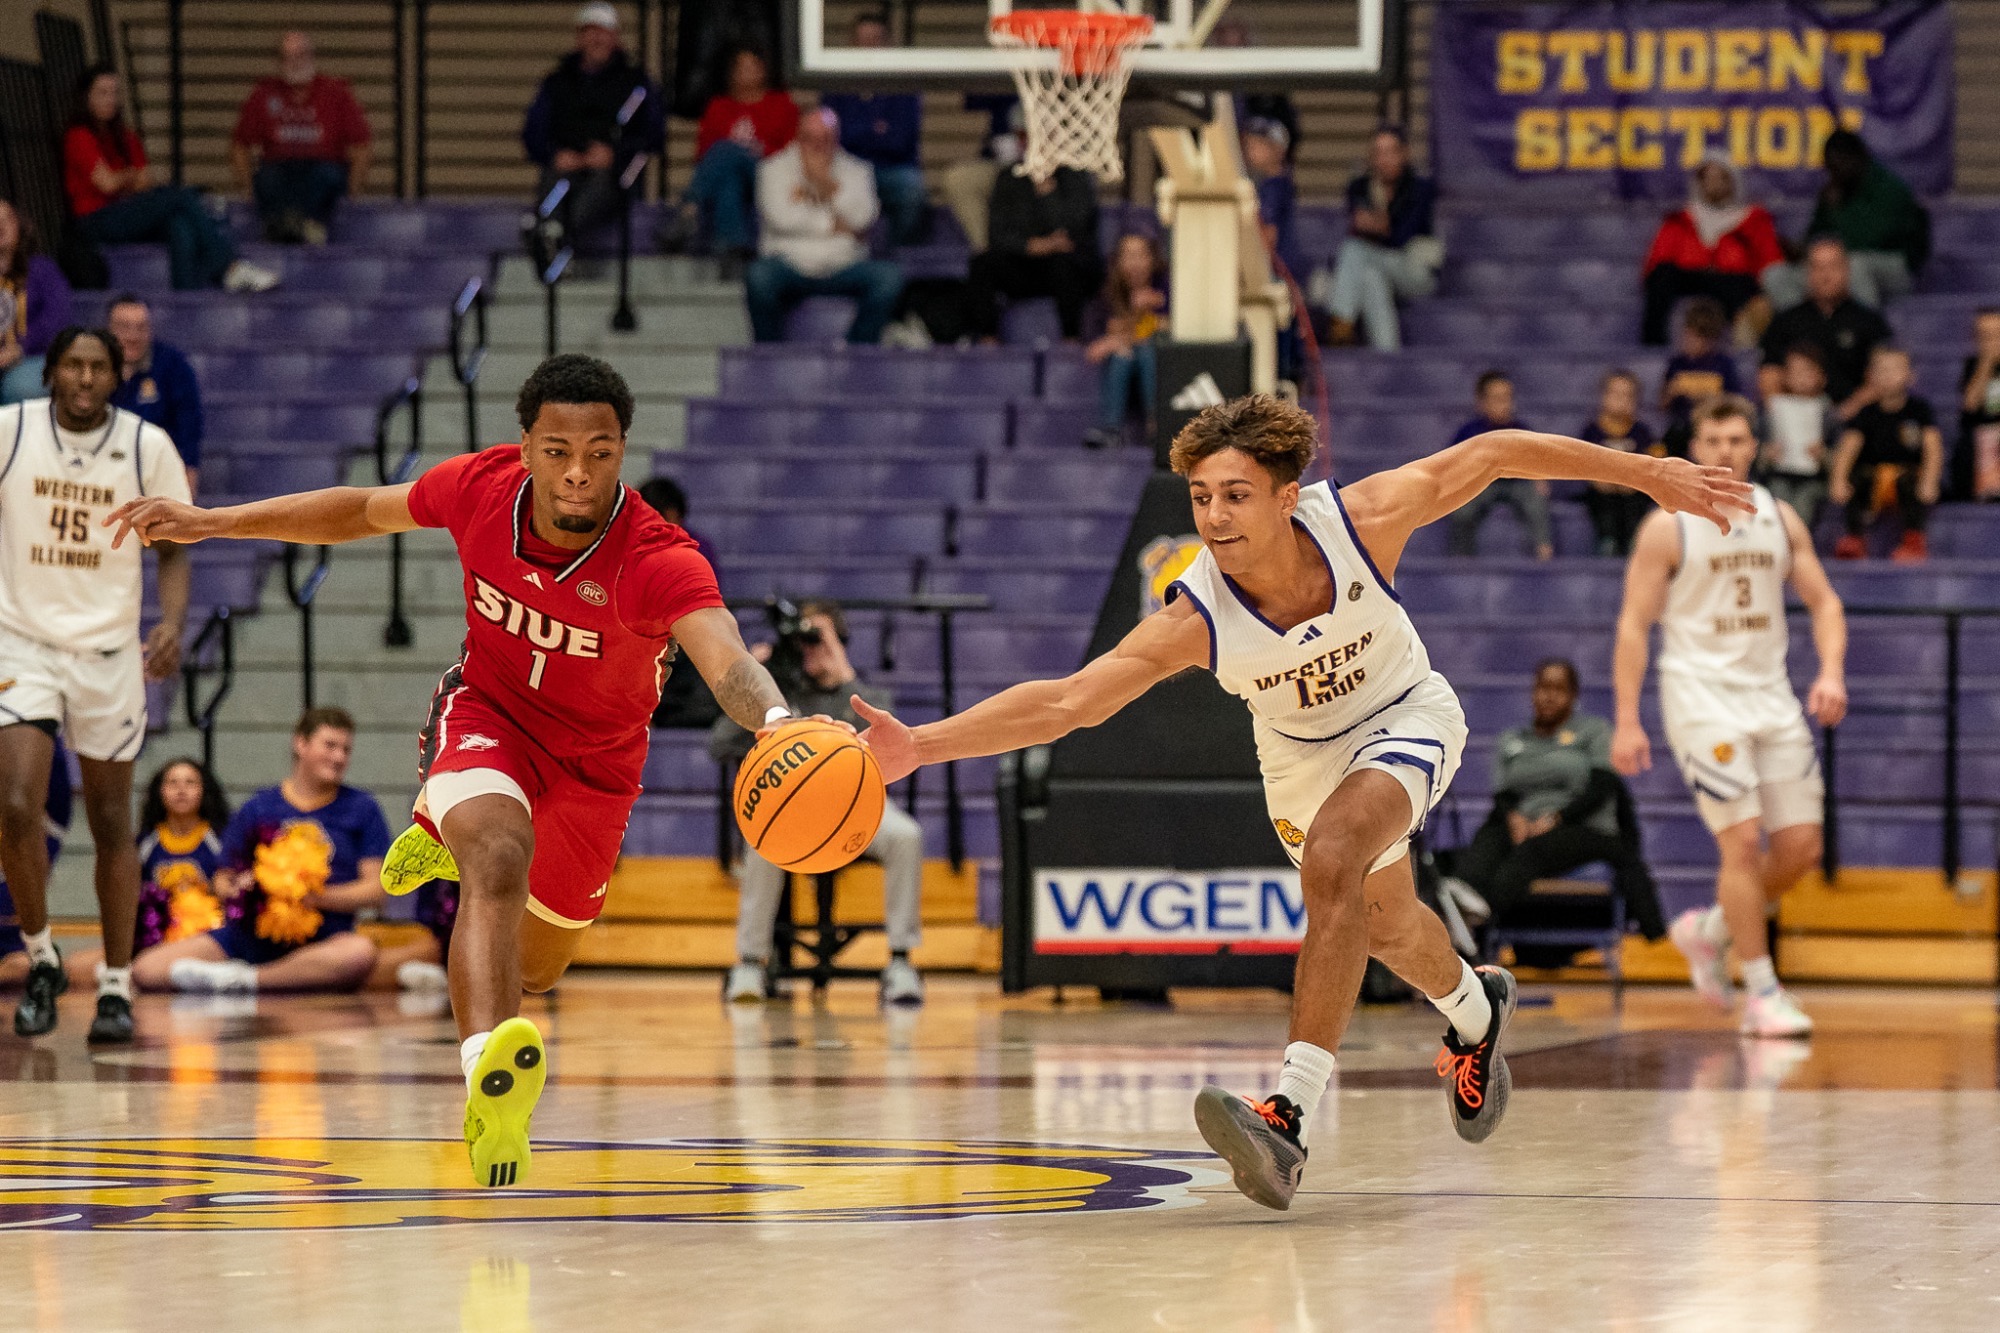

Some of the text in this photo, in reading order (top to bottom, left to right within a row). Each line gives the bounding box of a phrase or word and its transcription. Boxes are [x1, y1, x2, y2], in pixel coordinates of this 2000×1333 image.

[1497, 28, 1885, 94] STUDENT
[34, 477, 114, 507] WESTERN
[50, 504, 89, 543] 45
[31, 545, 101, 570] ILLINOIS
[583, 586, 602, 601] OVC
[1734, 575, 1752, 608] 3
[472, 574, 601, 659] SIUE
[527, 649, 548, 691] 1
[1253, 630, 1373, 691] WESTERN
[742, 740, 818, 821] Wilson
